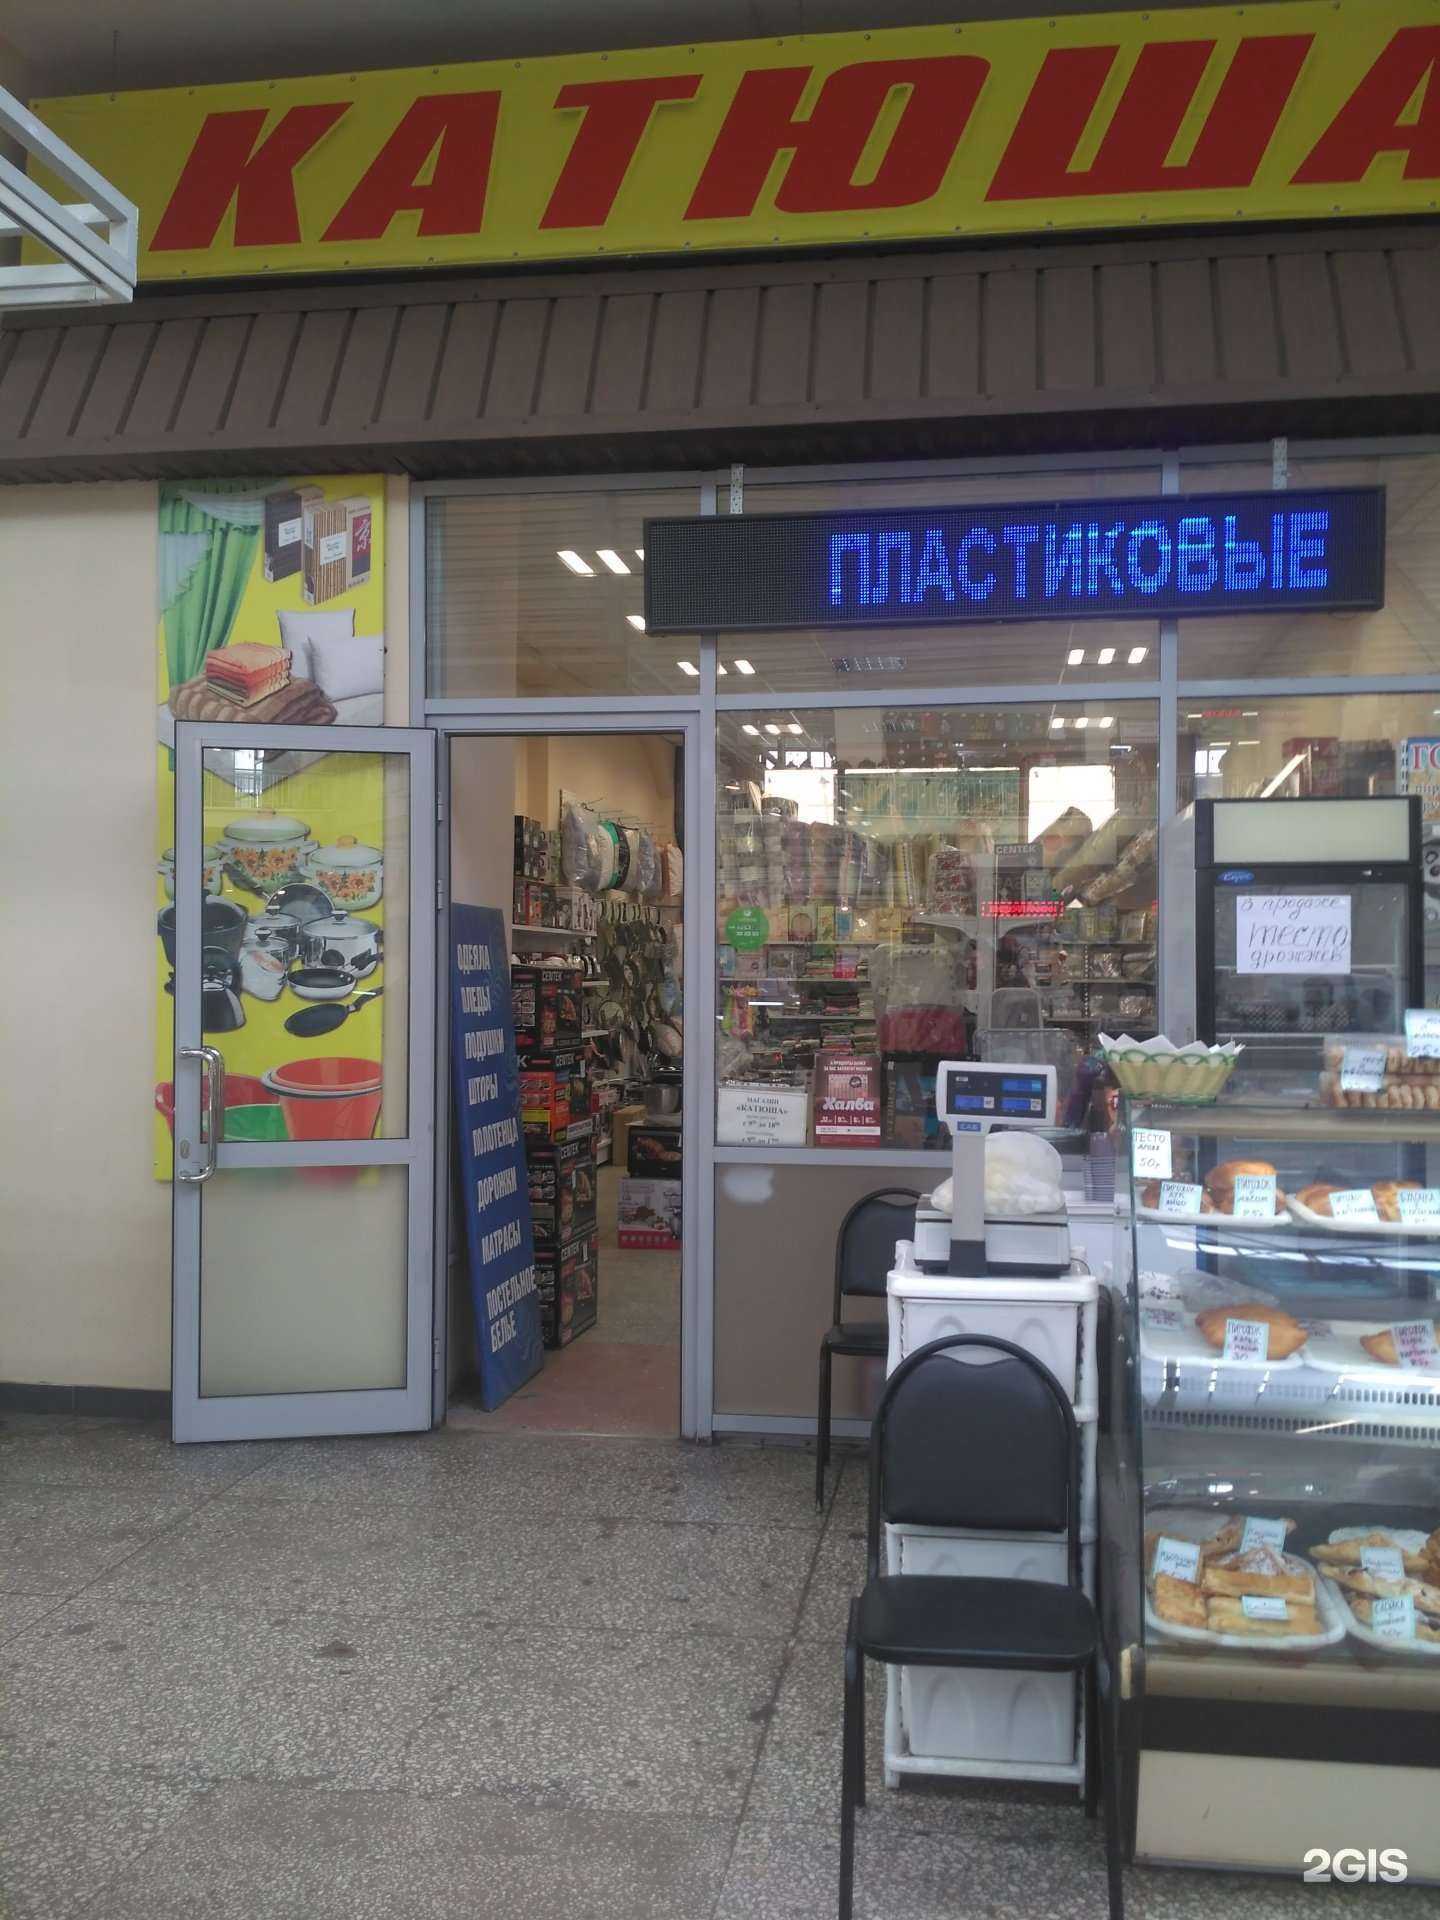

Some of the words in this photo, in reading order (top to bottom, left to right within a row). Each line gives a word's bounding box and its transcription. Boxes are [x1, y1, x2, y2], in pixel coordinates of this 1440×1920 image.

[148, 28, 1440, 253] КАТЮША
[828, 510, 1330, 606] ПЛАСТИКОВЫЕ
[457, 943, 491, 975] ОДЕЯЛА
[461, 986, 492, 1016] ПЛЕДЫ
[465, 1028, 505, 1062] ПОДУШКИ
[468, 1072, 499, 1106] ШТОРЫ
[822, 1096, 875, 1112] Халва
[472, 1117, 519, 1157] ПОЛОТЕНЦА
[478, 1166, 518, 1214] ДОРОЖКИ
[482, 1218, 521, 1265] МАТРАСЫ
[486, 1264, 537, 1321] ПОСТЕЛЬНОЕ
